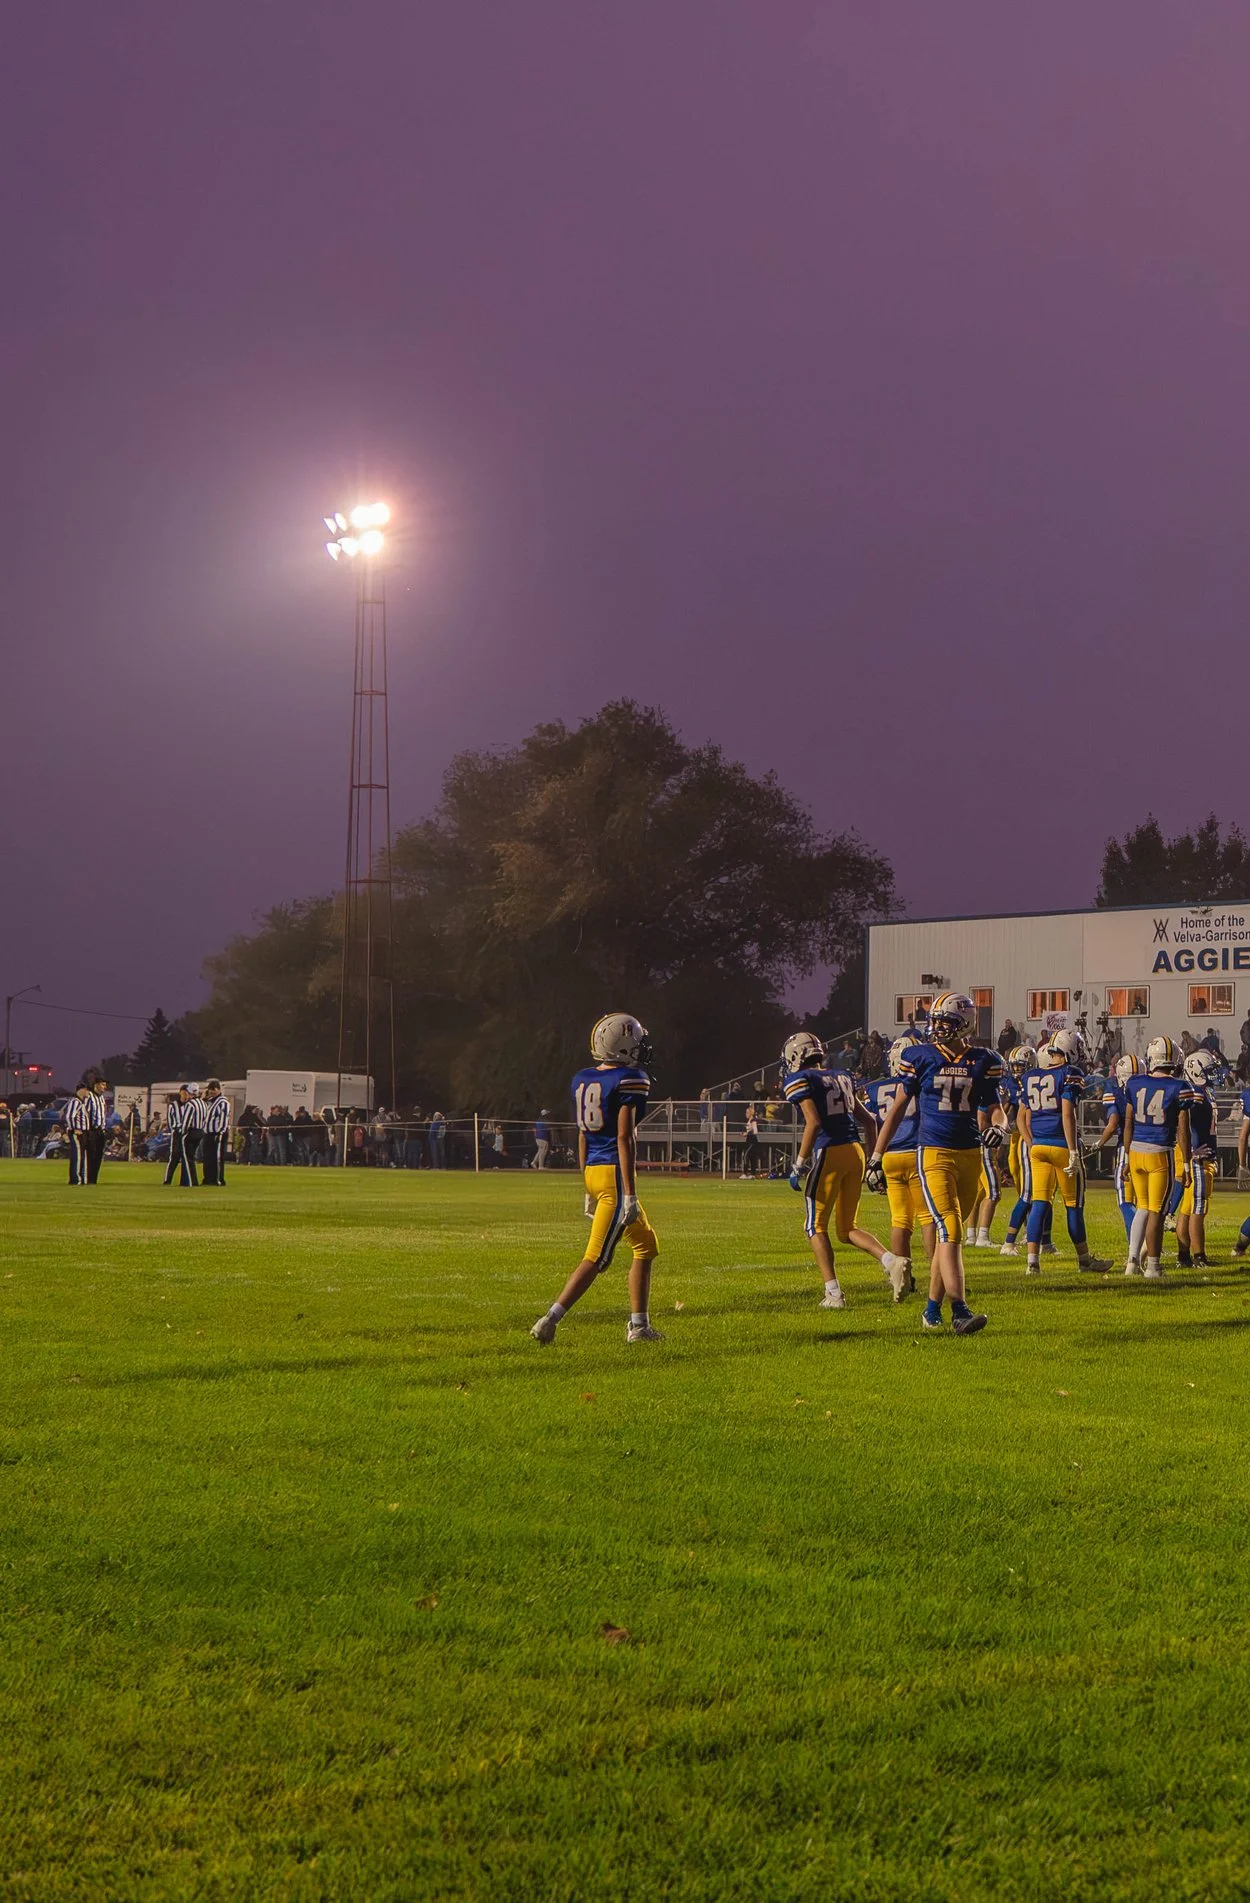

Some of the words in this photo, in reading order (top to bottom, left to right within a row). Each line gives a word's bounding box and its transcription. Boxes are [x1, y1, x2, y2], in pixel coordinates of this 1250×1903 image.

[1181, 917, 1211, 928] Home
[1214, 915, 1225, 927] of
[1228, 914, 1245, 926] the
[1187, 1060, 1194, 1069] 15
[576, 1083, 604, 1131] 18
[934, 1076, 973, 1111] 77
[1027, 1074, 1058, 1111] 52
[1135, 1088, 1166, 1124] 14
